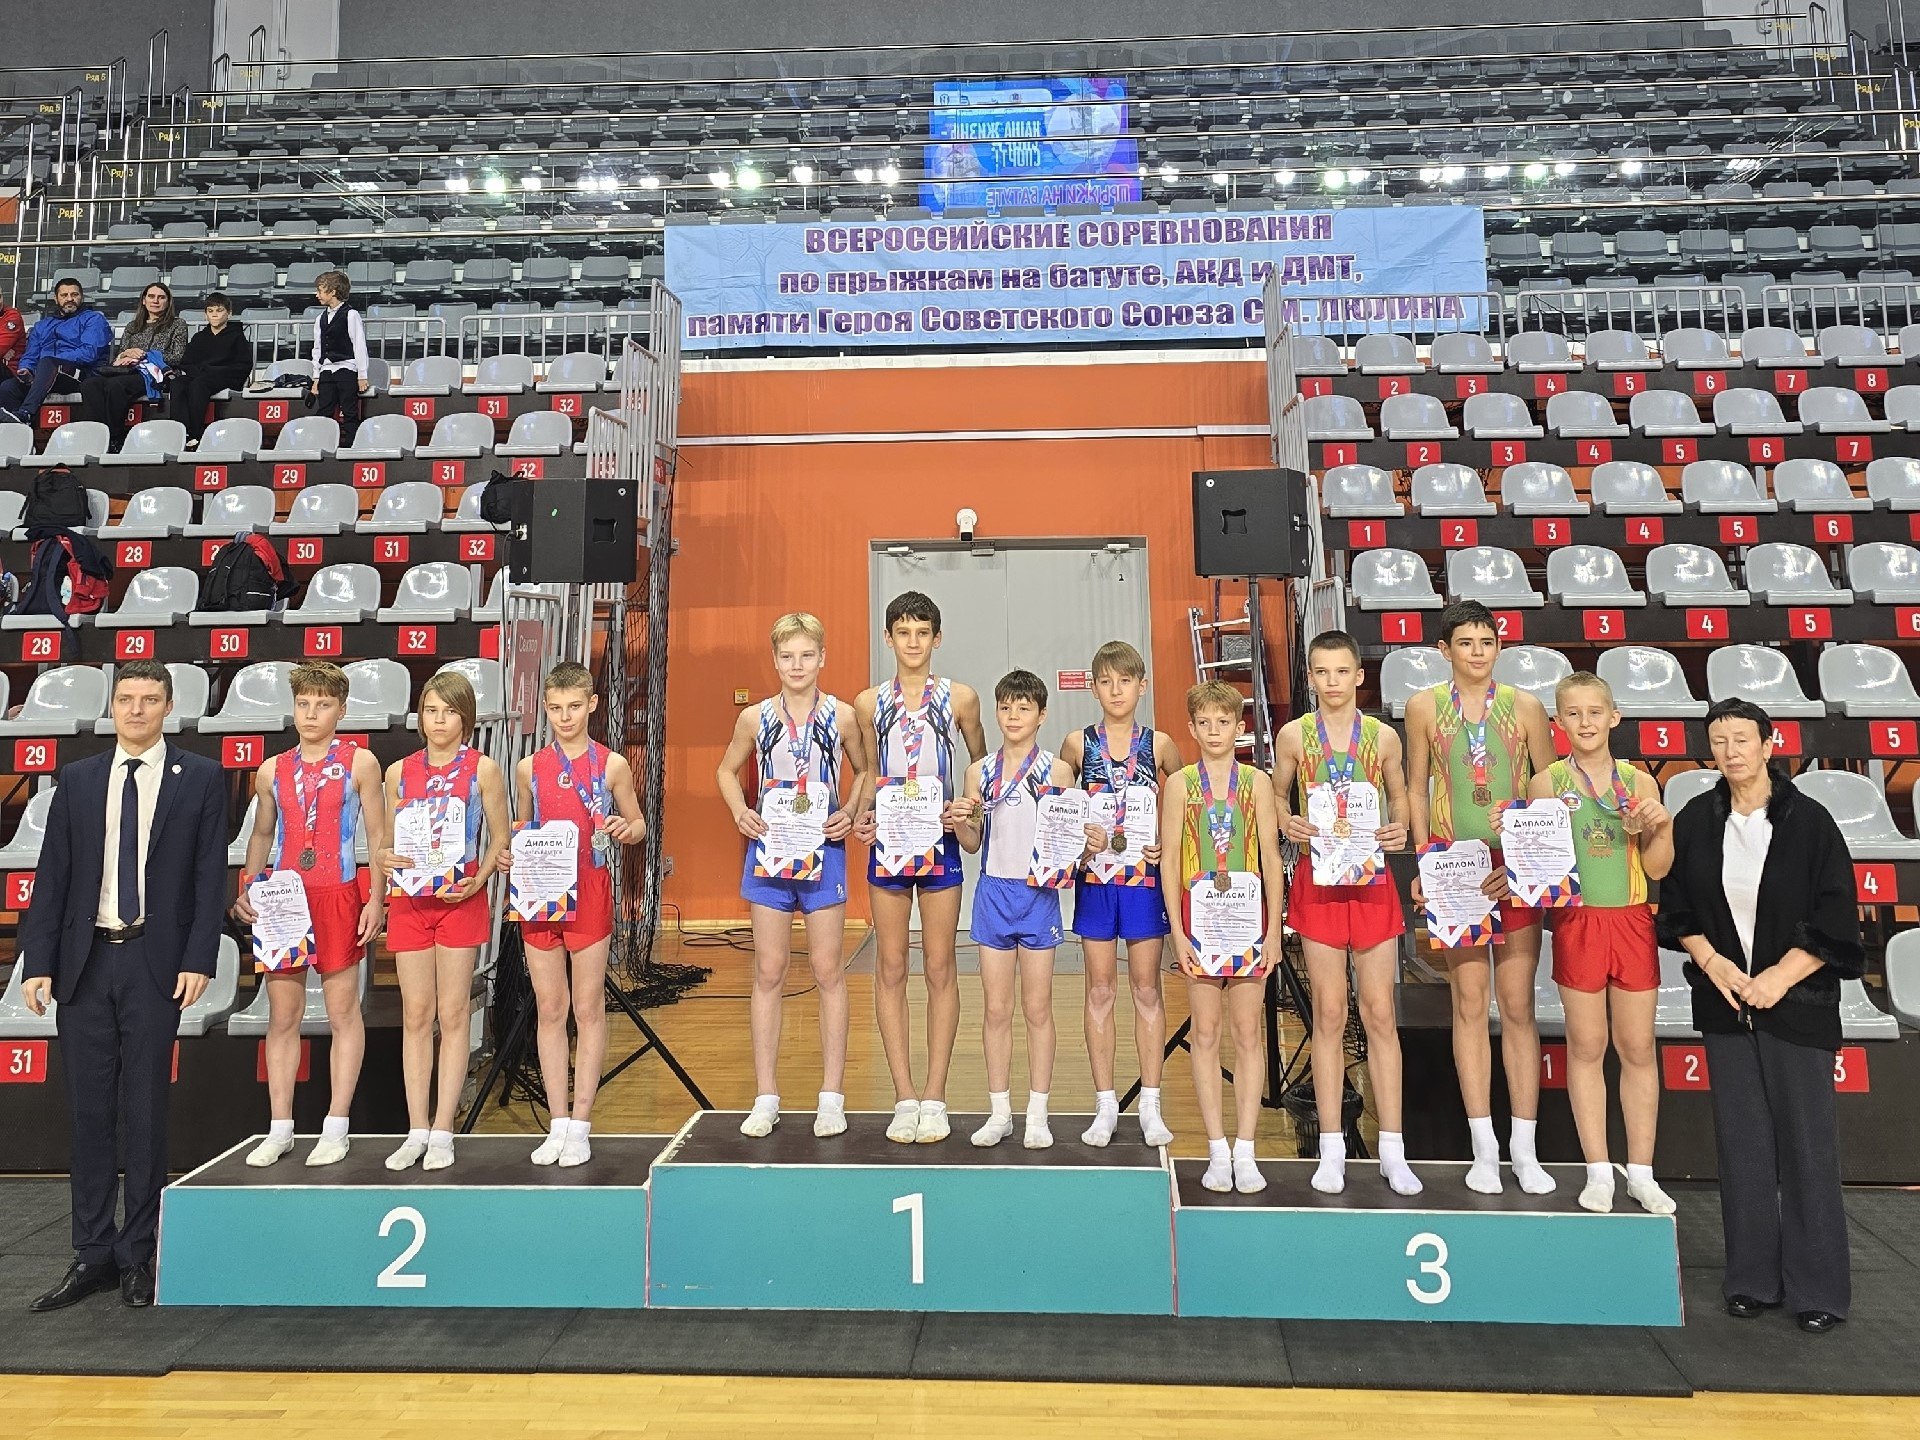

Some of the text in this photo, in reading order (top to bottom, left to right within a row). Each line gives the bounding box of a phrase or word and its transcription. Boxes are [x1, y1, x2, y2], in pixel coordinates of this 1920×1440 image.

[85, 73, 99, 82] Ряд
[1874, 84, 1880, 92] 4
[40, 104, 54, 113] Ряд
[175, 132, 180, 141] 4
[129, 168, 134, 177] 3
[806, 214, 1333, 253] ВСЕРОССИЙСКИЕ СОРЕВНОВАНИЯ
[778, 253, 1363, 296] по прыжкам на батуте, АКД и ДМТ,
[687, 312, 811, 339] памяти
[818, 307, 914, 335] Героя
[921, 303, 1113, 332] Советского
[1121, 301, 1234, 328] Союза
[1316, 296, 1466, 323] ЛЮЛИНА
[1314, 381, 1320, 395] 1
[1390, 382, 1399, 395] 2
[1467, 379, 1476, 394] 3
[1546, 378, 1556, 392] 4
[1625, 376, 1635, 391] 5
[1706, 375, 1715, 390] 6
[1787, 374, 1796, 388] 7
[1867, 373, 1877, 388] 8
[266, 405, 281, 419] 28
[412, 403, 427, 417] 30
[487, 401, 500, 414] 31
[559, 399, 574, 412] 32
[47, 410, 62, 424] 25
[1337, 449, 1344, 464] 1
[1420, 447, 1428, 461] 2
[1504, 446, 1514, 461] 3
[1590, 444, 1600, 459] 4
[1675, 444, 1685, 459] 5
[1762, 443, 1772, 458] 6
[1849, 442, 1859, 456] 7
[203, 470, 219, 486] 28
[282, 469, 299, 484] 29
[361, 468, 379, 483] 30
[442, 466, 456, 481] 31
[1364, 525, 1371, 542] 1
[1454, 525, 1465, 541] 2
[1547, 523, 1557, 540] 3
[1639, 522, 1650, 538] 4
[1734, 521, 1744, 538] 5
[1827, 520, 1838, 536] 6
[125, 546, 143, 562] 28
[297, 543, 315, 559] 30
[384, 541, 399, 557] 31
[468, 540, 486, 556] 32
[1398, 618, 1406, 635] 1
[1497, 616, 1508, 635] 2
[1598, 615, 1610, 633] 3
[1701, 614, 1714, 632] 4
[1804, 614, 1817, 632] 5
[31, 637, 52, 655] 28
[126, 635, 145, 653] 29
[220, 634, 239, 652] 30
[315, 632, 331, 650] 31
[407, 630, 427, 648] 32
[519, 634, 537, 656] Сектор
[1656, 727, 1669, 748] 3
[1772, 727, 1785, 748] 4
[1887, 727, 1901, 748] 5
[25, 745, 46, 766] 29
[235, 742, 252, 762] 31
[1864, 871, 1878, 895] 4
[10, 1049, 32, 1074] 31
[1543, 1053, 1552, 1080] 1
[1685, 1054, 1700, 1081] 2
[1835, 1055, 1847, 1083] 3
[892, 1192, 924, 1285] 1
[376, 1206, 427, 1288] 2
[1404, 1231, 1452, 1304] 3
